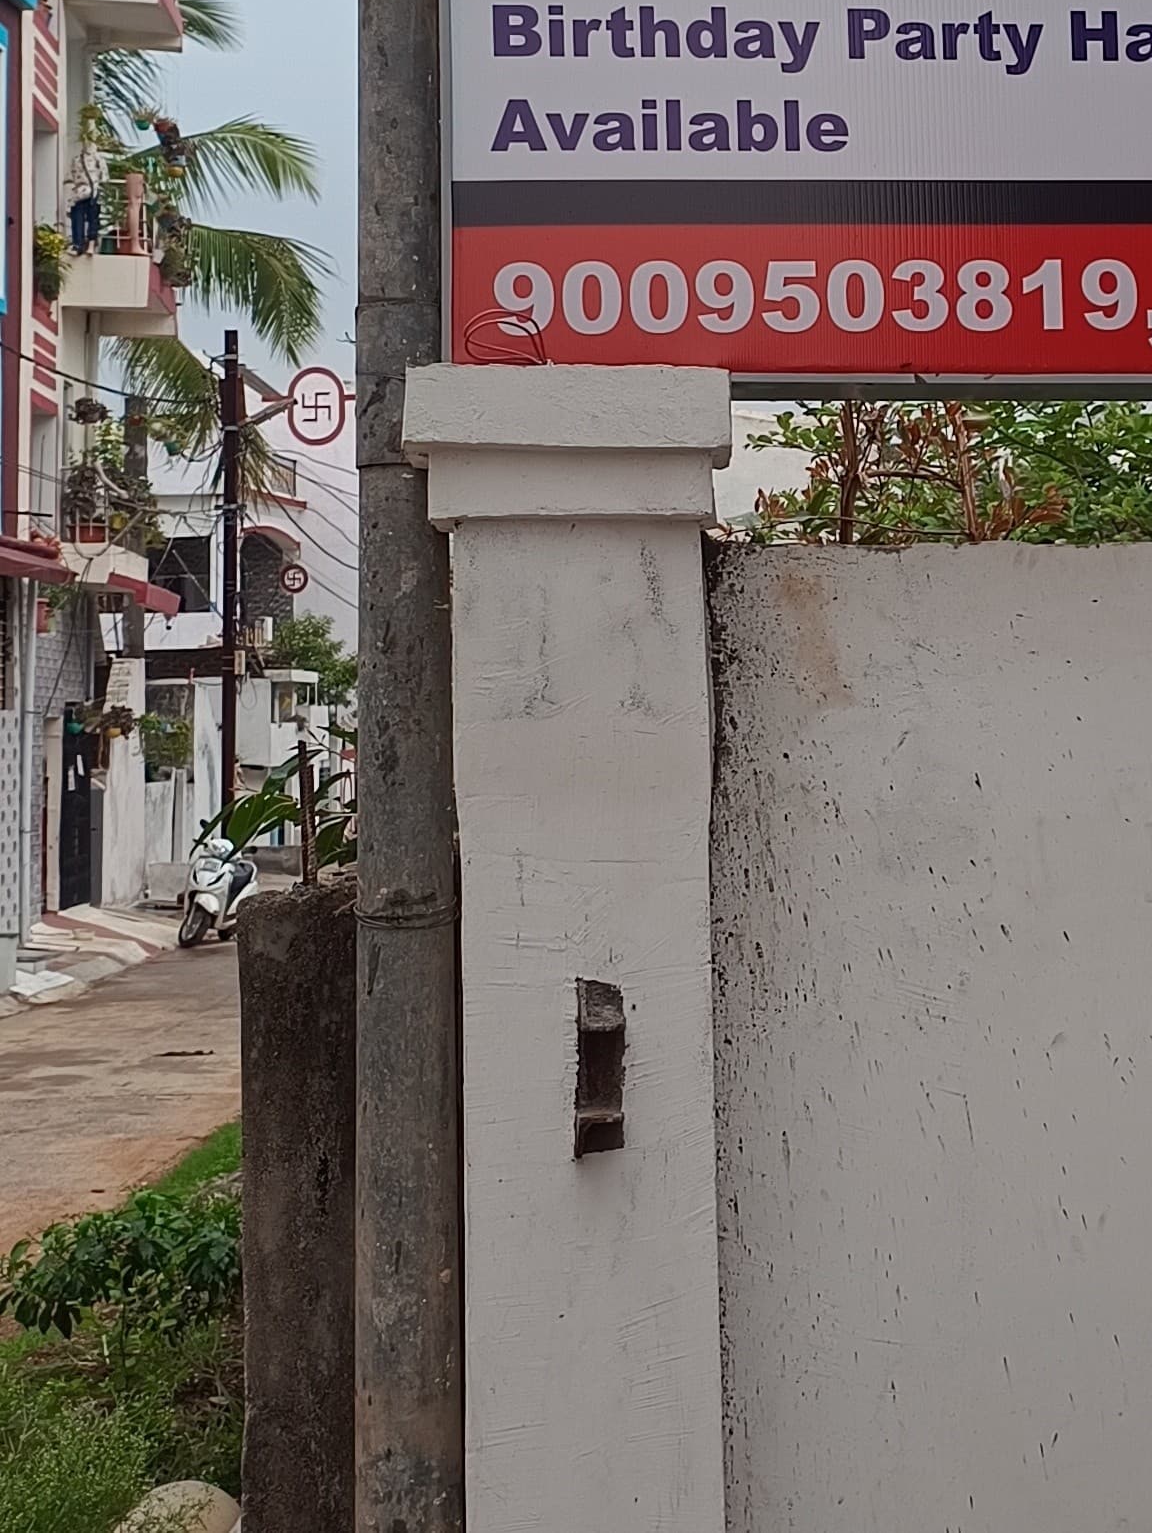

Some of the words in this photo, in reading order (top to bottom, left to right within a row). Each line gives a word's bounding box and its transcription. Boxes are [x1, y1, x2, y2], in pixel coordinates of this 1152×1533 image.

[491, 3, 820, 73] Birthday
[847, 8, 1043, 74] Party
[490, 98, 849, 152] Available
